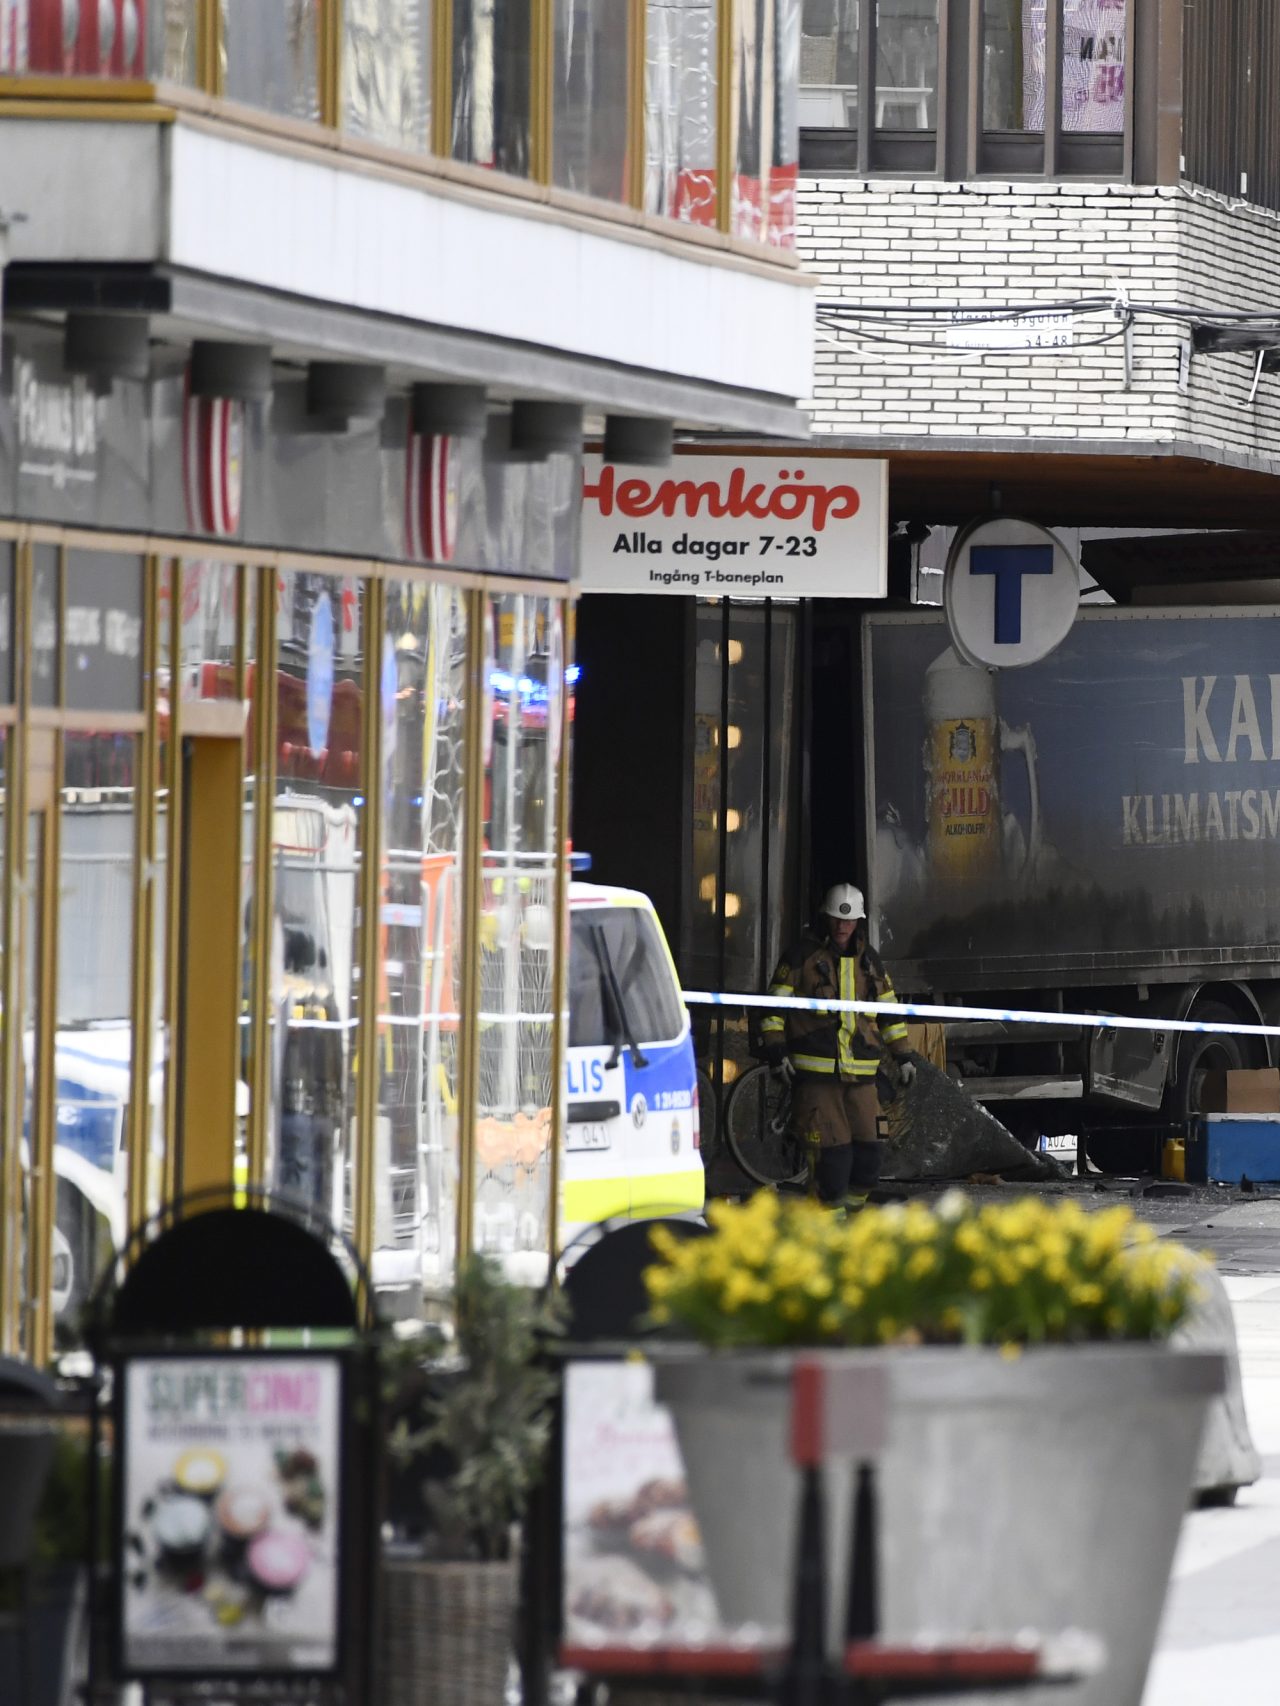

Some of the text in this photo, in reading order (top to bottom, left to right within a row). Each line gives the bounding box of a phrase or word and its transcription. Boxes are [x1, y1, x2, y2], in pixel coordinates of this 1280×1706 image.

[582, 465, 860, 531] Hemköp
[613, 531, 818, 561] Alla dagar 7-23
[649, 569, 784, 586] Ingång T-baneplan
[969, 544, 1054, 644] T
[940, 787, 991, 818] GULD
[567, 1059, 603, 1093] LIS
